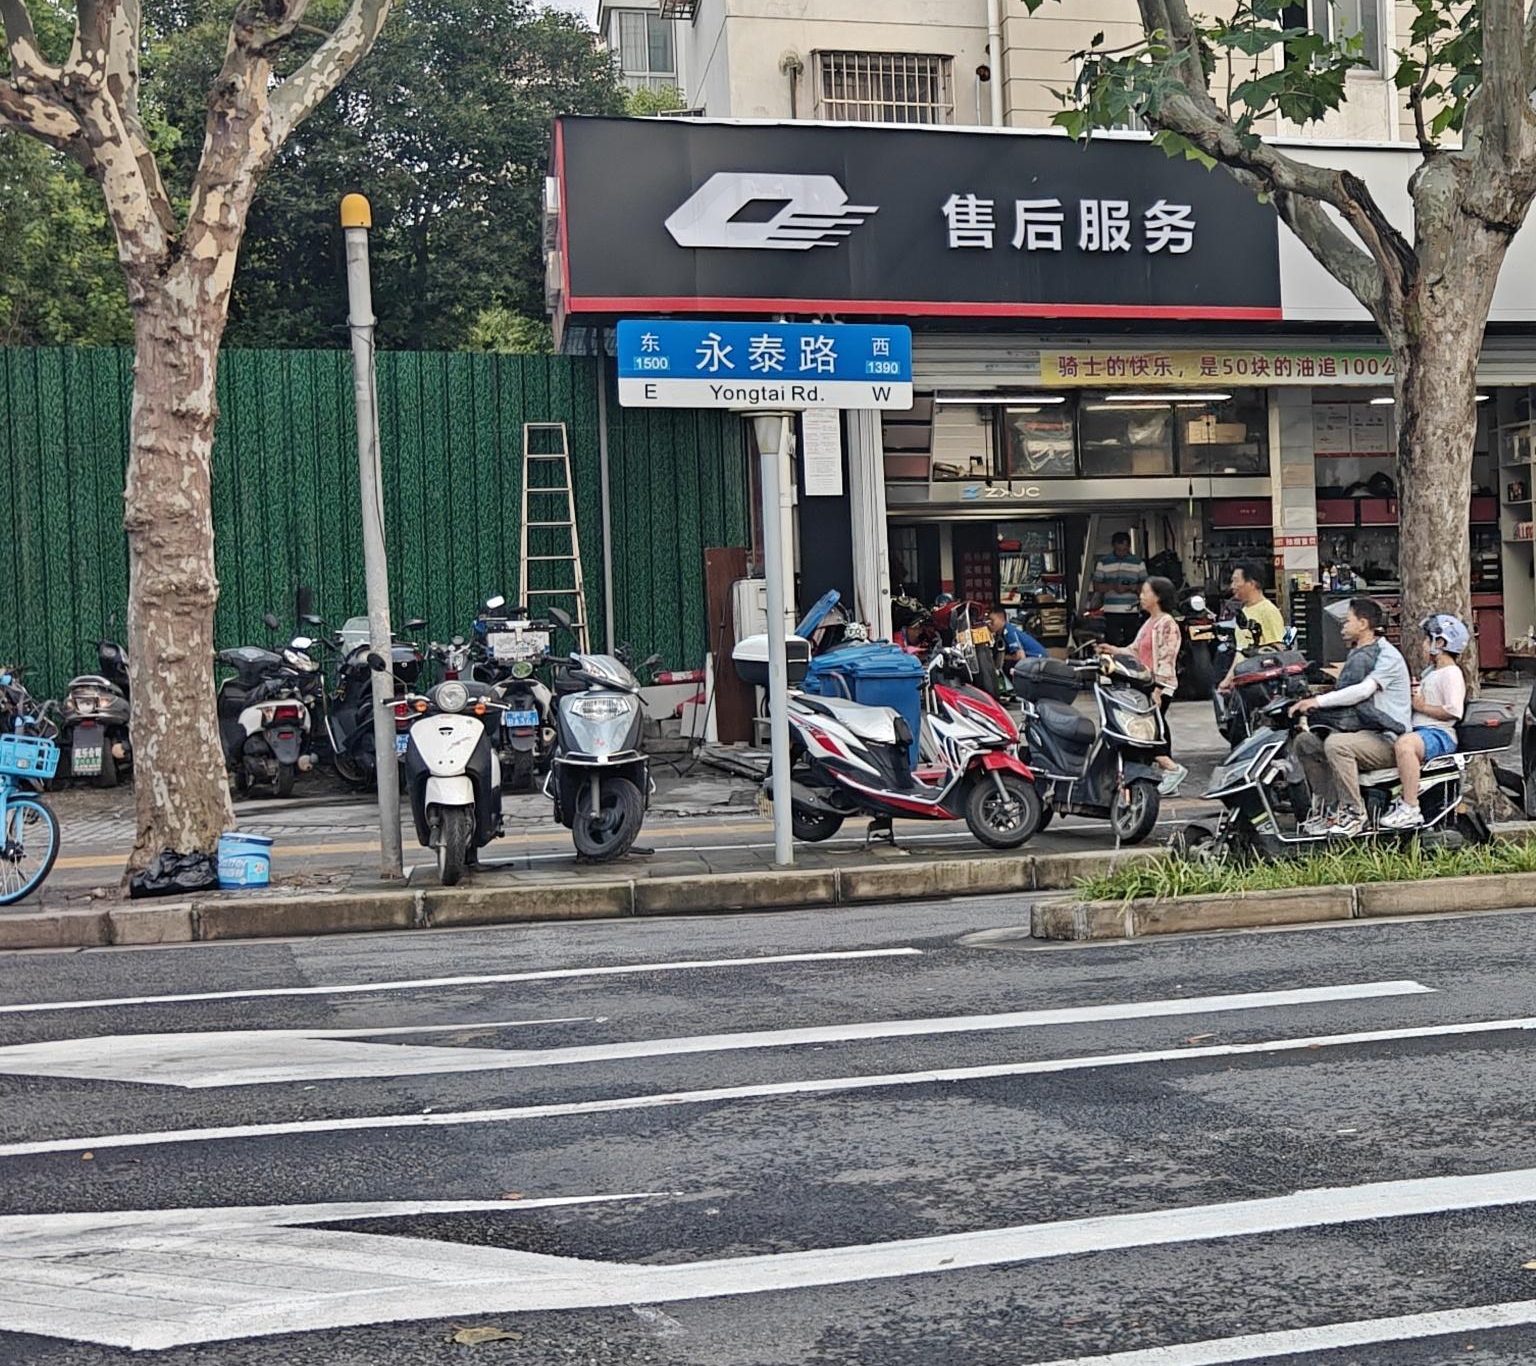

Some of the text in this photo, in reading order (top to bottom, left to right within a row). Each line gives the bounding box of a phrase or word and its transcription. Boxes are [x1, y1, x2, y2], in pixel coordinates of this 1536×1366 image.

[942, 193, 1197, 254] 售后服务
[635, 356, 898, 374] 1500 1390
[640, 331, 891, 374] 东 永泰路 西
[645, 384, 892, 404] E Yongtai Rd. W
